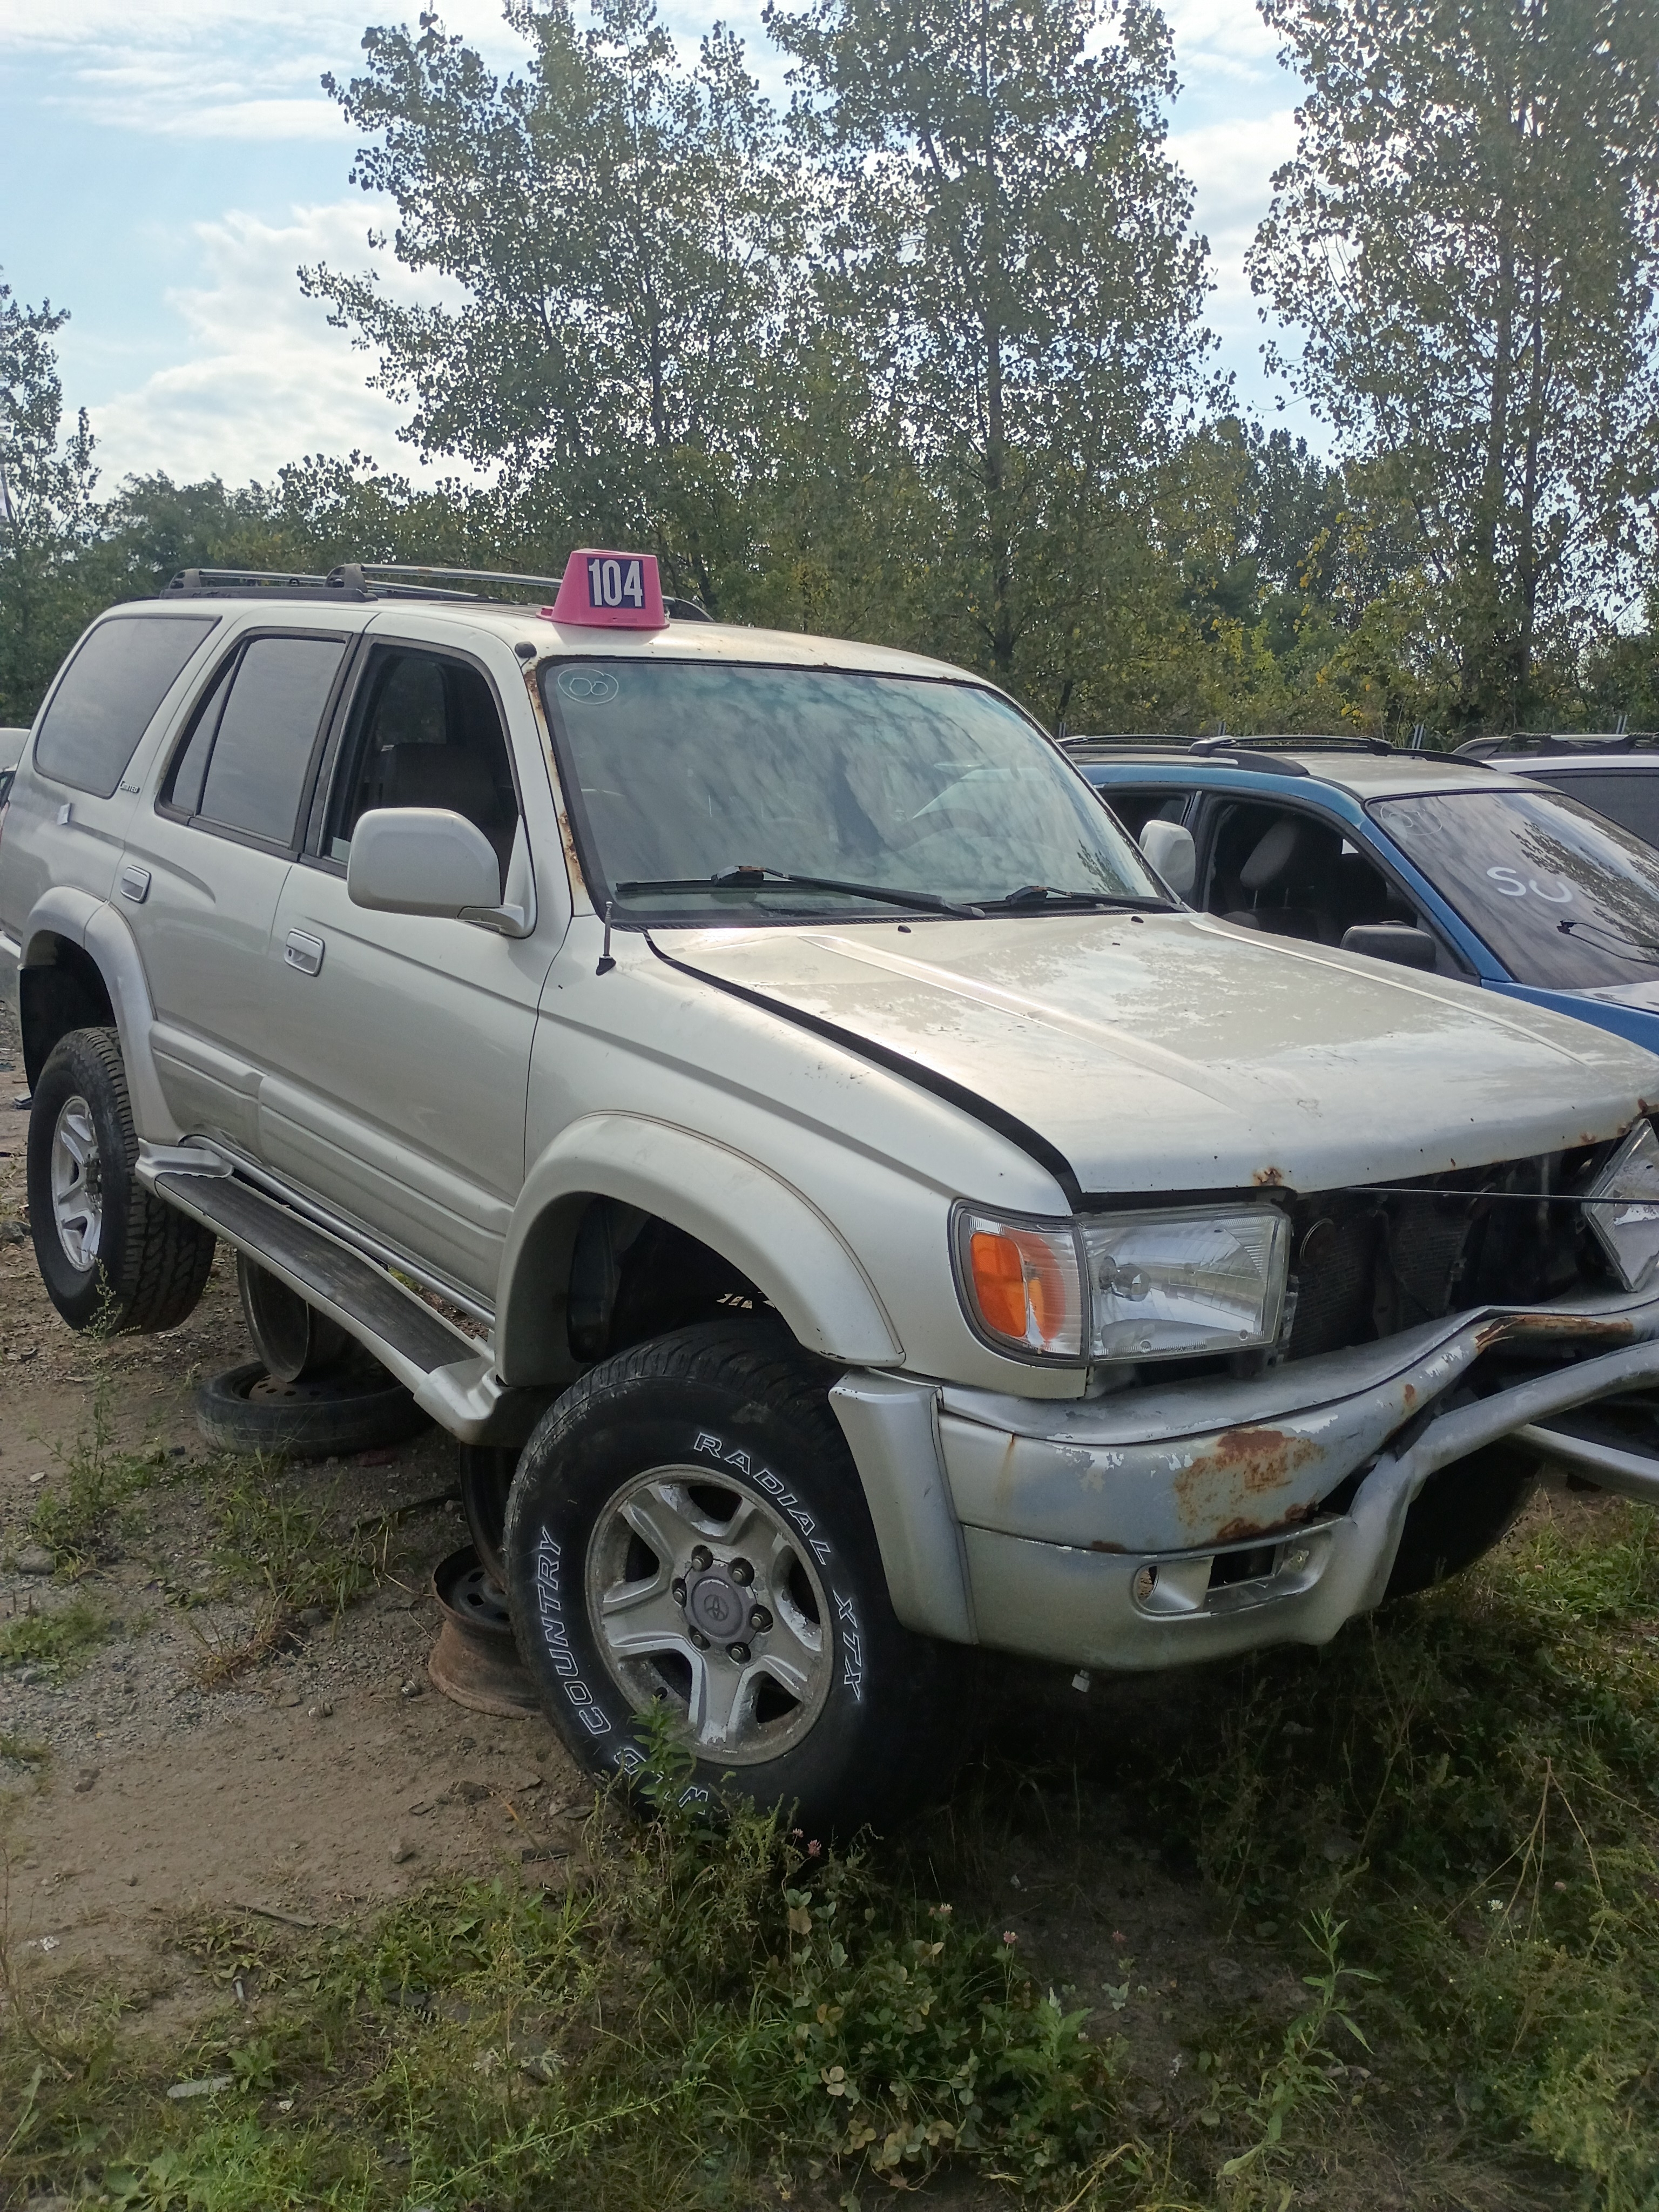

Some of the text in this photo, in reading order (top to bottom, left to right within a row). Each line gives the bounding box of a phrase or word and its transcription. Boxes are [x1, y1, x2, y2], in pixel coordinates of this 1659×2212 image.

[589, 559, 643, 607] 104
[538, 1526, 611, 1735] COUNTRY
[694, 1432, 862, 1701] RADIAL XTX
